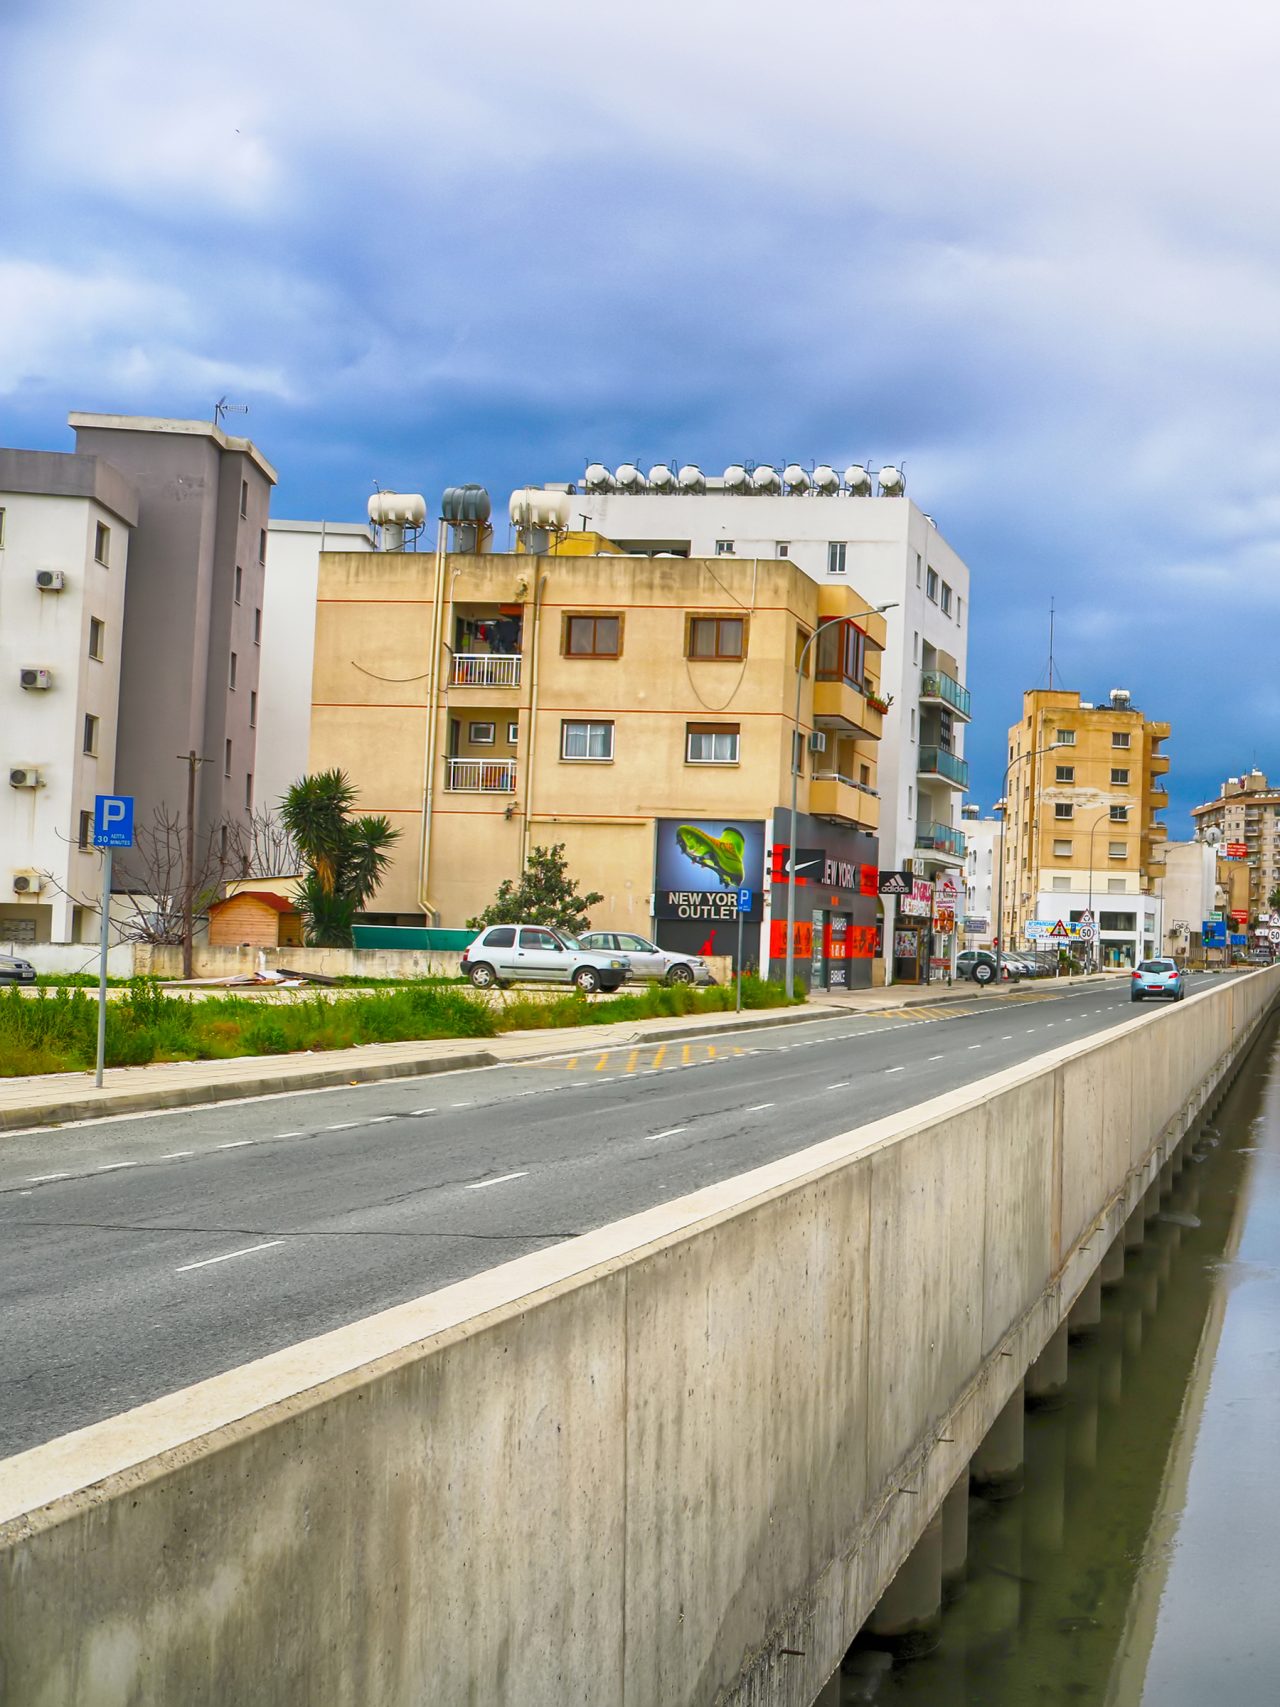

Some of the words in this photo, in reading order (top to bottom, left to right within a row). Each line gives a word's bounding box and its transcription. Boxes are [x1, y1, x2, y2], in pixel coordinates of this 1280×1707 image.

[102, 799, 126, 831] P
[97, 835, 109, 843] 30
[838, 861, 856, 889] YORK
[881, 885, 909, 893] adidas
[668, 892, 702, 905] NEW
[706, 892, 738, 906] YOR
[740, 889, 749, 905] P
[678, 905, 738, 919] OUTLET
[1081, 928, 1092, 938] 50
[1270, 931, 1280, 940] 50
